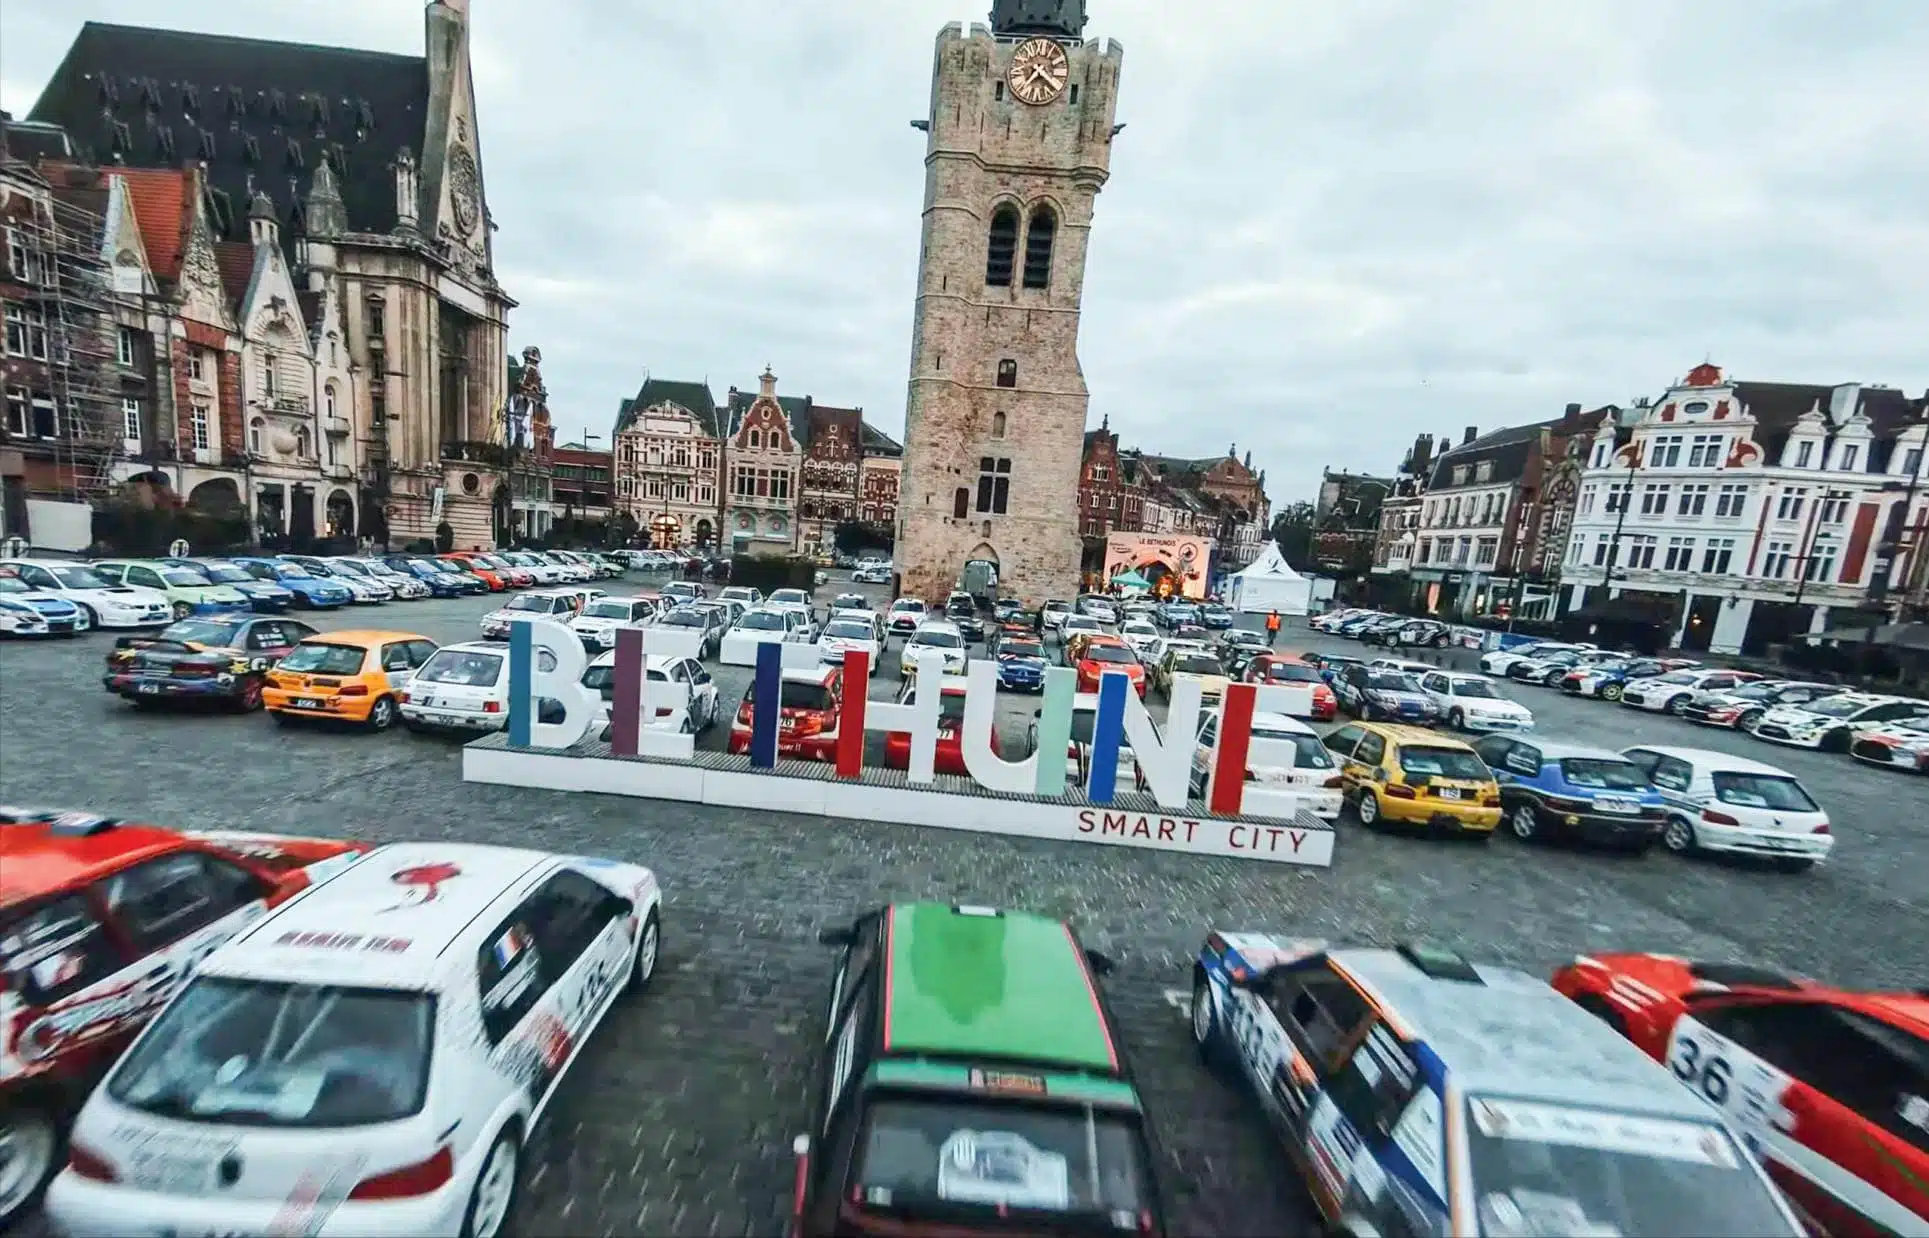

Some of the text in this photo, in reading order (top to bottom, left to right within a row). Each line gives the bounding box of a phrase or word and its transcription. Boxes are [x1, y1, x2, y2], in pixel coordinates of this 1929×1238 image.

[1078, 810, 1308, 853] SMART CITY
[1670, 1033, 1734, 1107] 36
